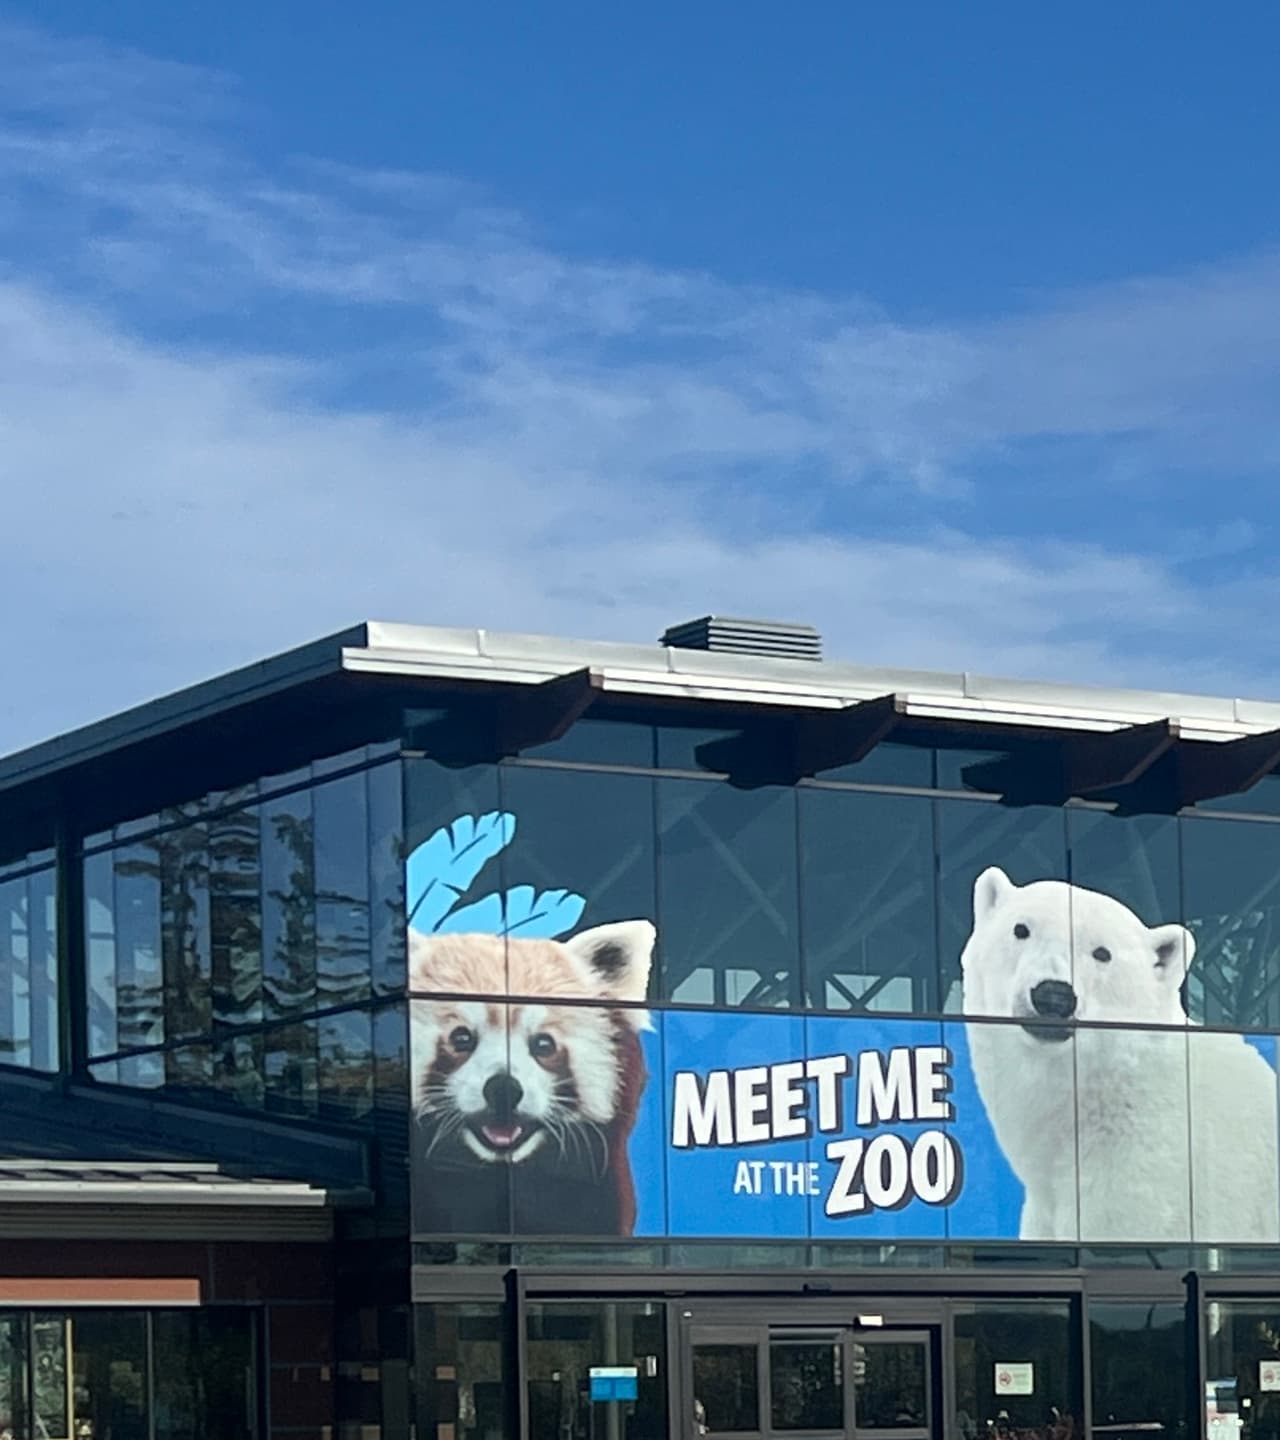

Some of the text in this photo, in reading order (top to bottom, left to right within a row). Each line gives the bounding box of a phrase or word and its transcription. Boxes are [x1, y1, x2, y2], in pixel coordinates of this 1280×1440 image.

[671, 1046, 953, 1150] MEET ME
[734, 1130, 962, 1219] AT THE ZOO
